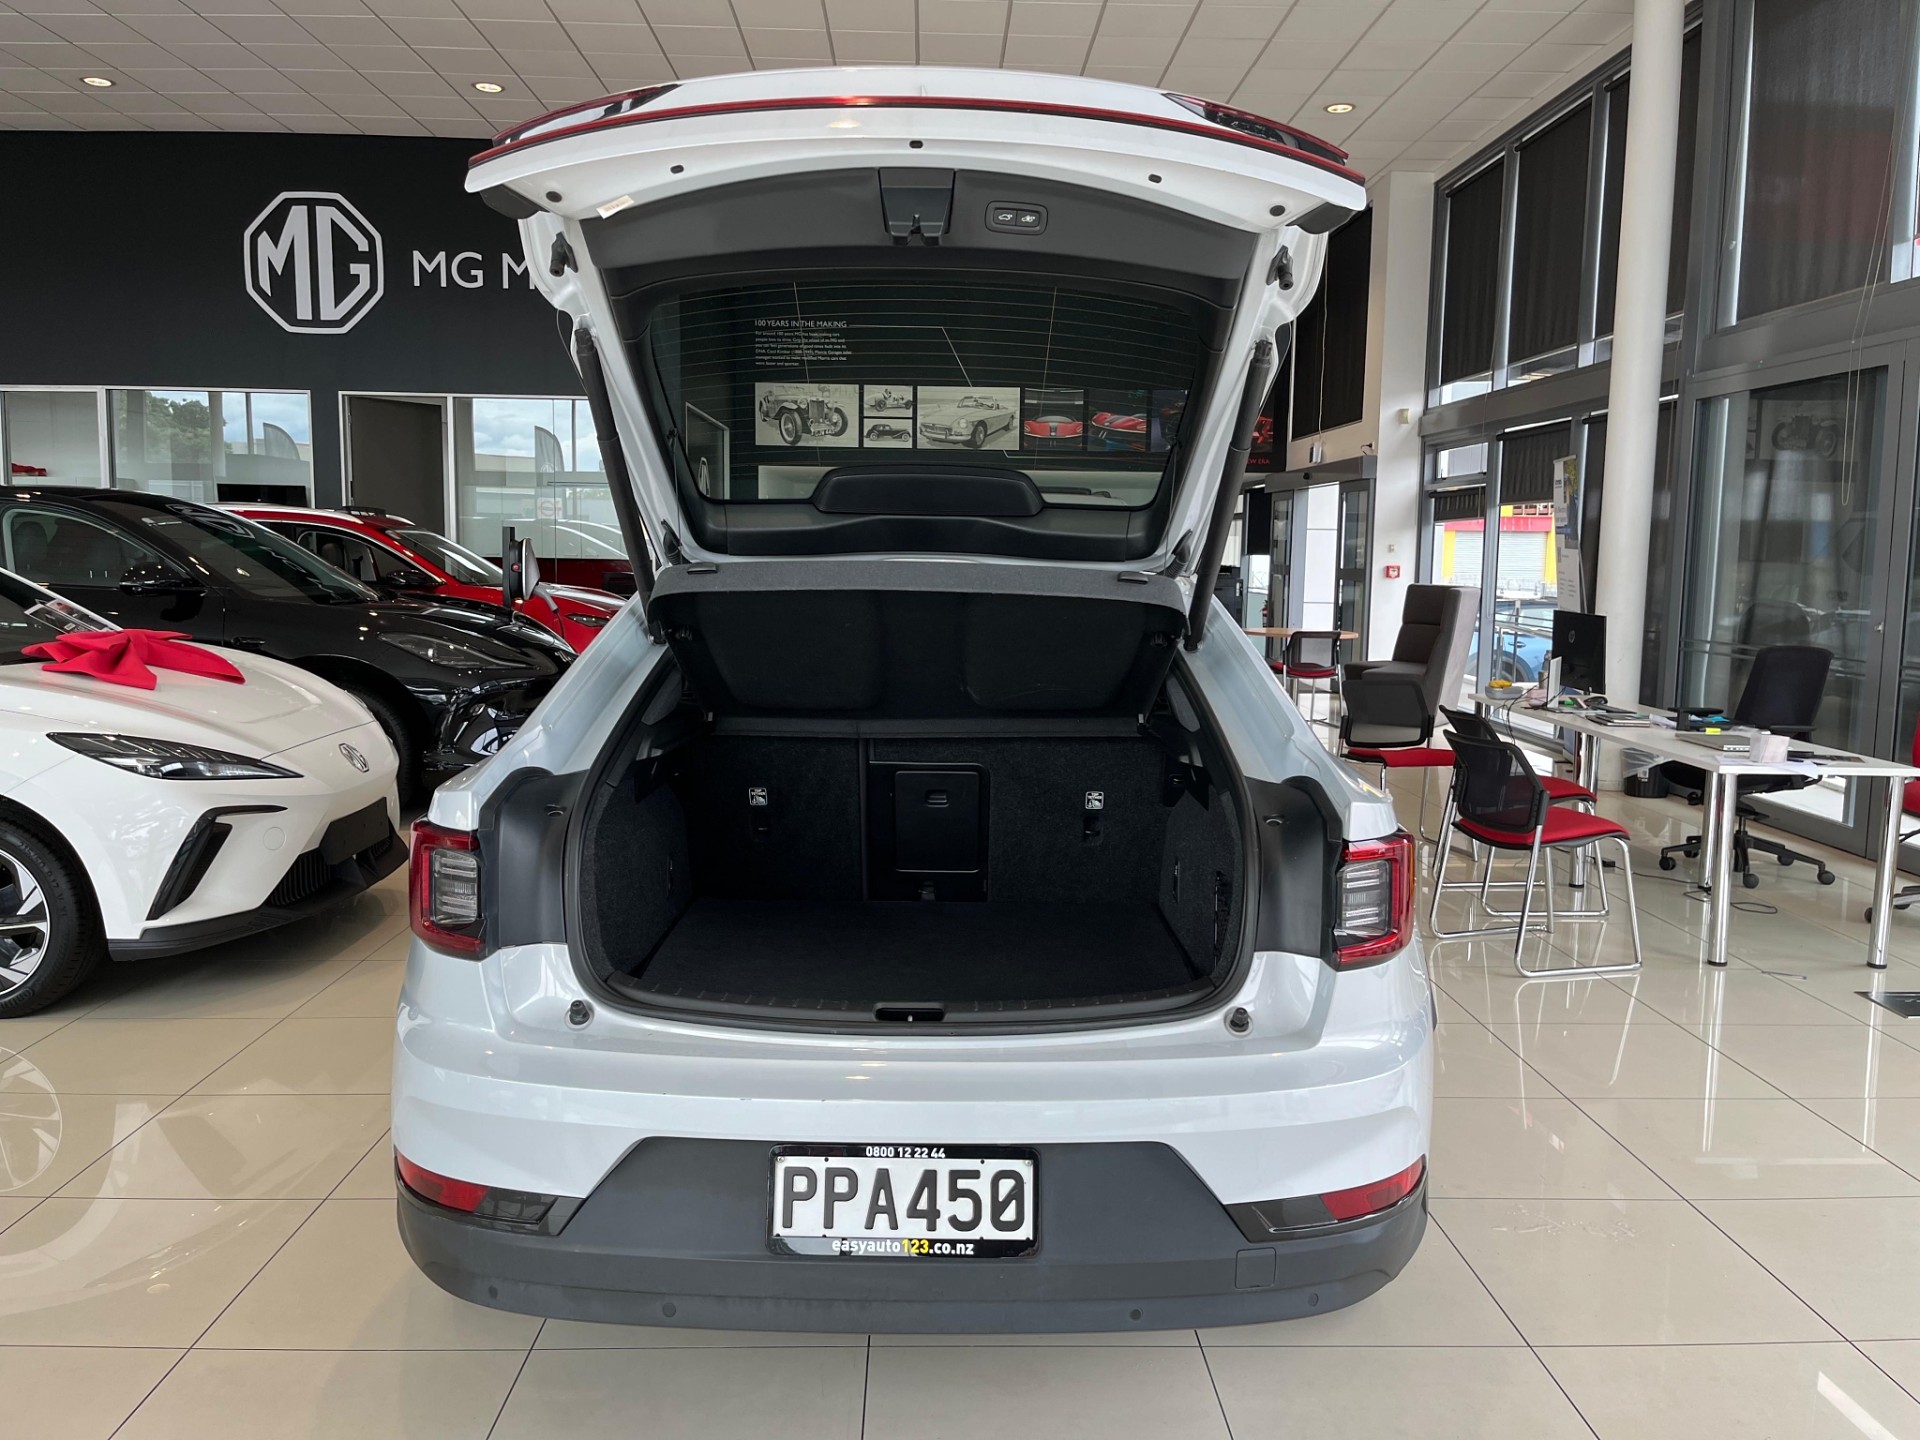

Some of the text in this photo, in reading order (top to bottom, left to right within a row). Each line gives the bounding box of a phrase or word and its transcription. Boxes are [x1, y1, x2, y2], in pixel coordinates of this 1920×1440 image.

[257, 205, 370, 320] MG
[413, 250, 484, 288] MG
[801, 320, 815, 328] THE
[816, 320, 847, 328] MAKING
[866, 1146, 945, 1159] 0800 12 22 44
[782, 1166, 1026, 1232] PPA450
[832, 1239, 974, 1255] easyauto123.co.nz
